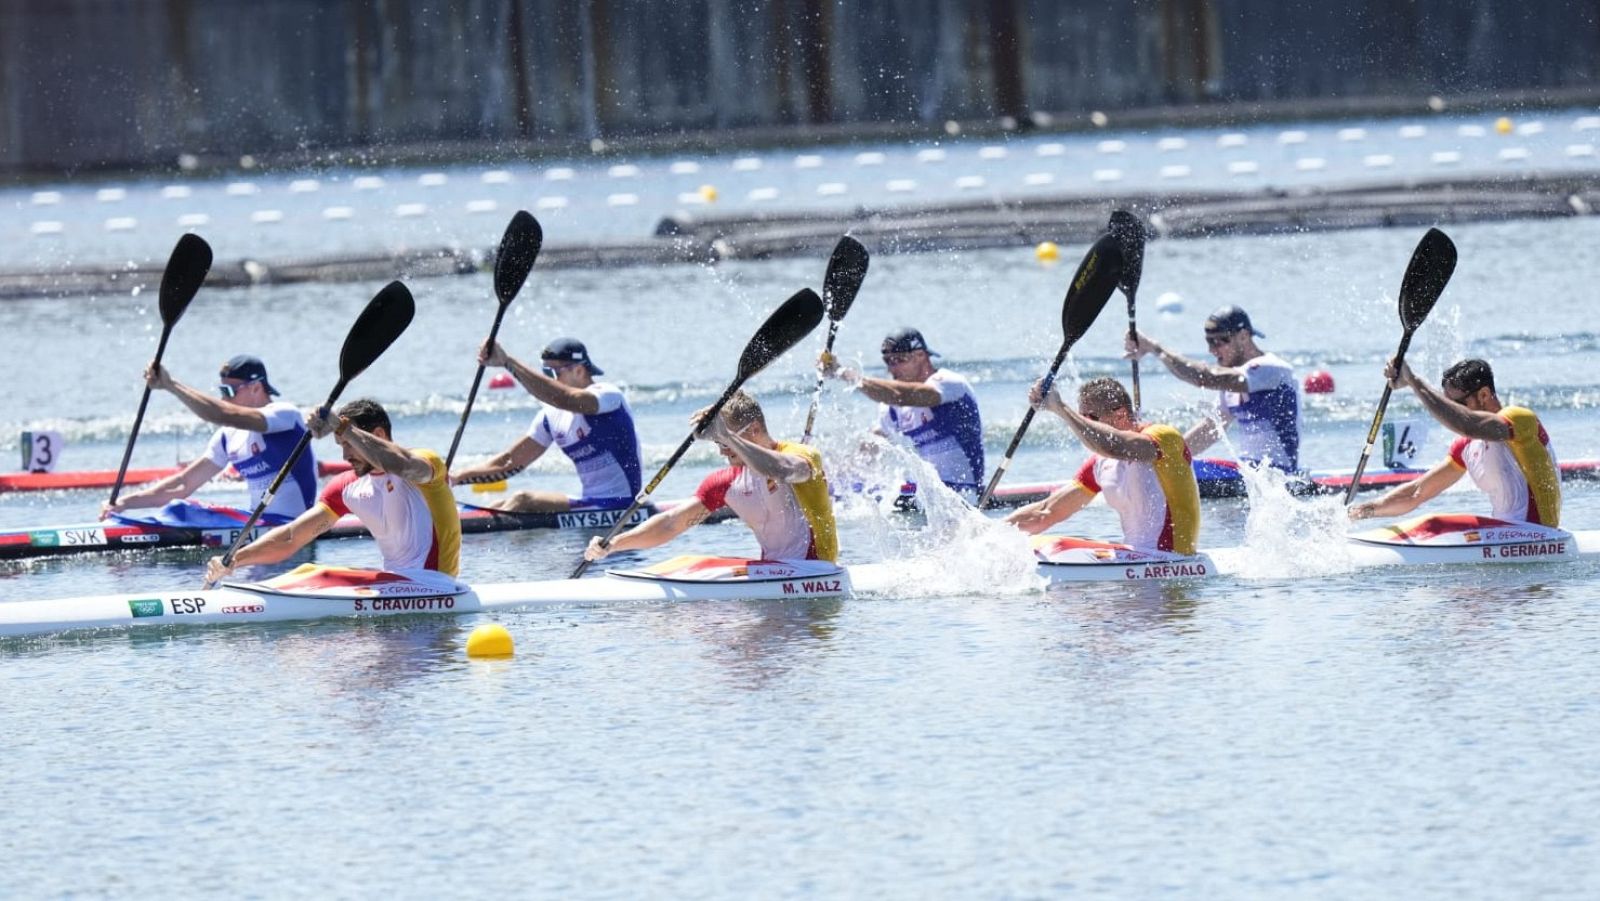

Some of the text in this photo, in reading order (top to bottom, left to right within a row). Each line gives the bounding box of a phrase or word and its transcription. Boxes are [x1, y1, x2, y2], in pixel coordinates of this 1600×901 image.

[1397, 425, 1416, 459] 4
[36, 435, 52, 466] 3
[65, 530, 100, 544] SVK
[1482, 543, 1565, 558] R. GERMADE
[1126, 564, 1206, 579] C. AREVALO
[782, 581, 842, 594] M. WALZ
[170, 598, 206, 614] ESP
[354, 597, 454, 611] S. CRAVIOTTO
